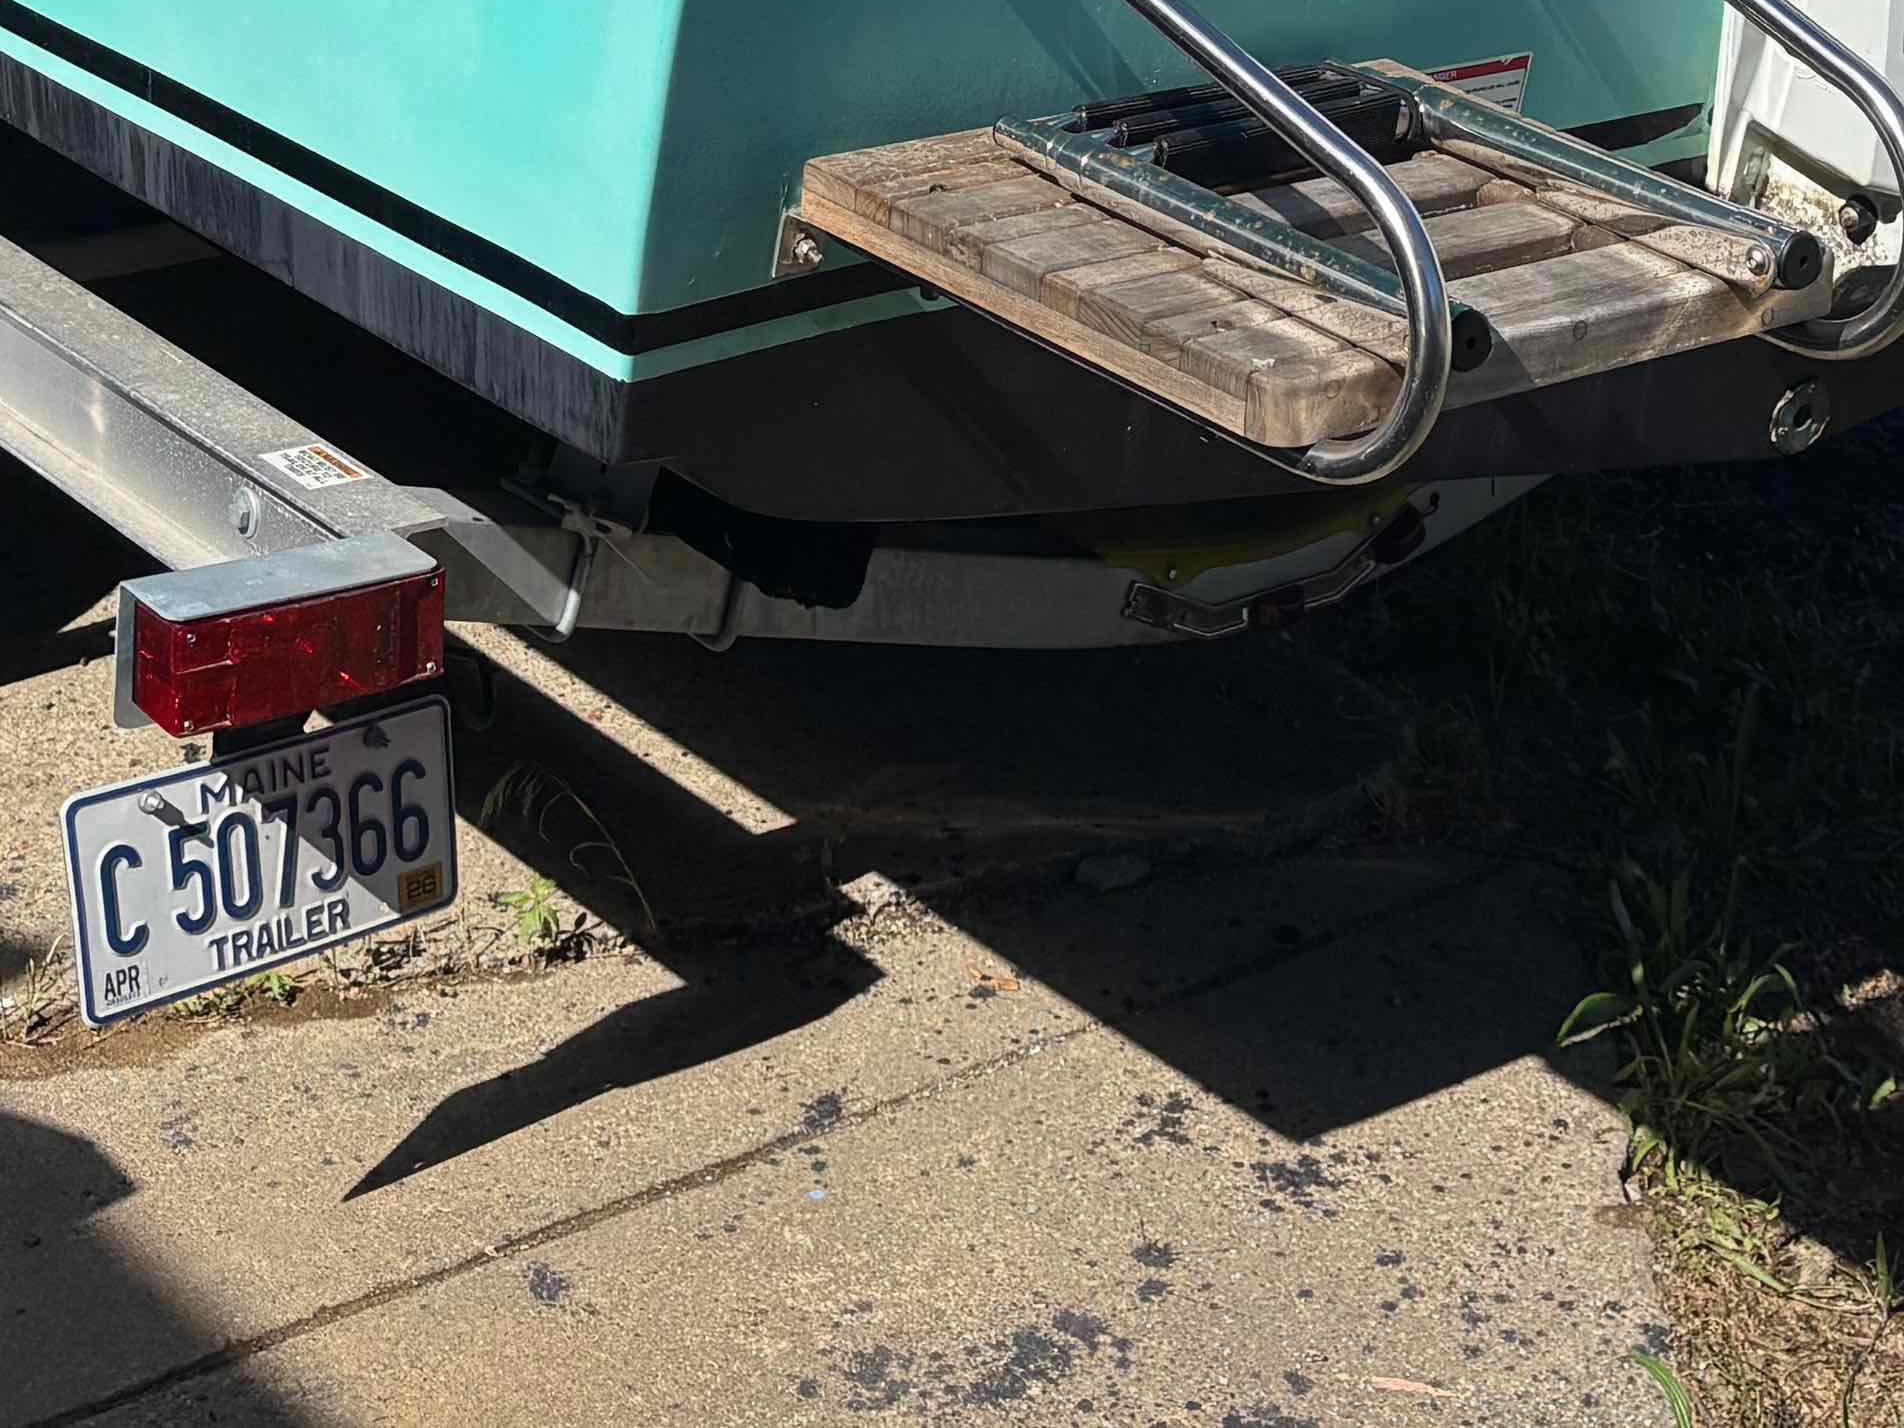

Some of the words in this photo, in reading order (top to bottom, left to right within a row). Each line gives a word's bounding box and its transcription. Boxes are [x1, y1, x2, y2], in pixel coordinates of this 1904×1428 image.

[200, 746, 332, 815] MAINE
[167, 758, 431, 936] 507366
[208, 898, 351, 972] TRAILER
[104, 964, 141, 1001] APR
